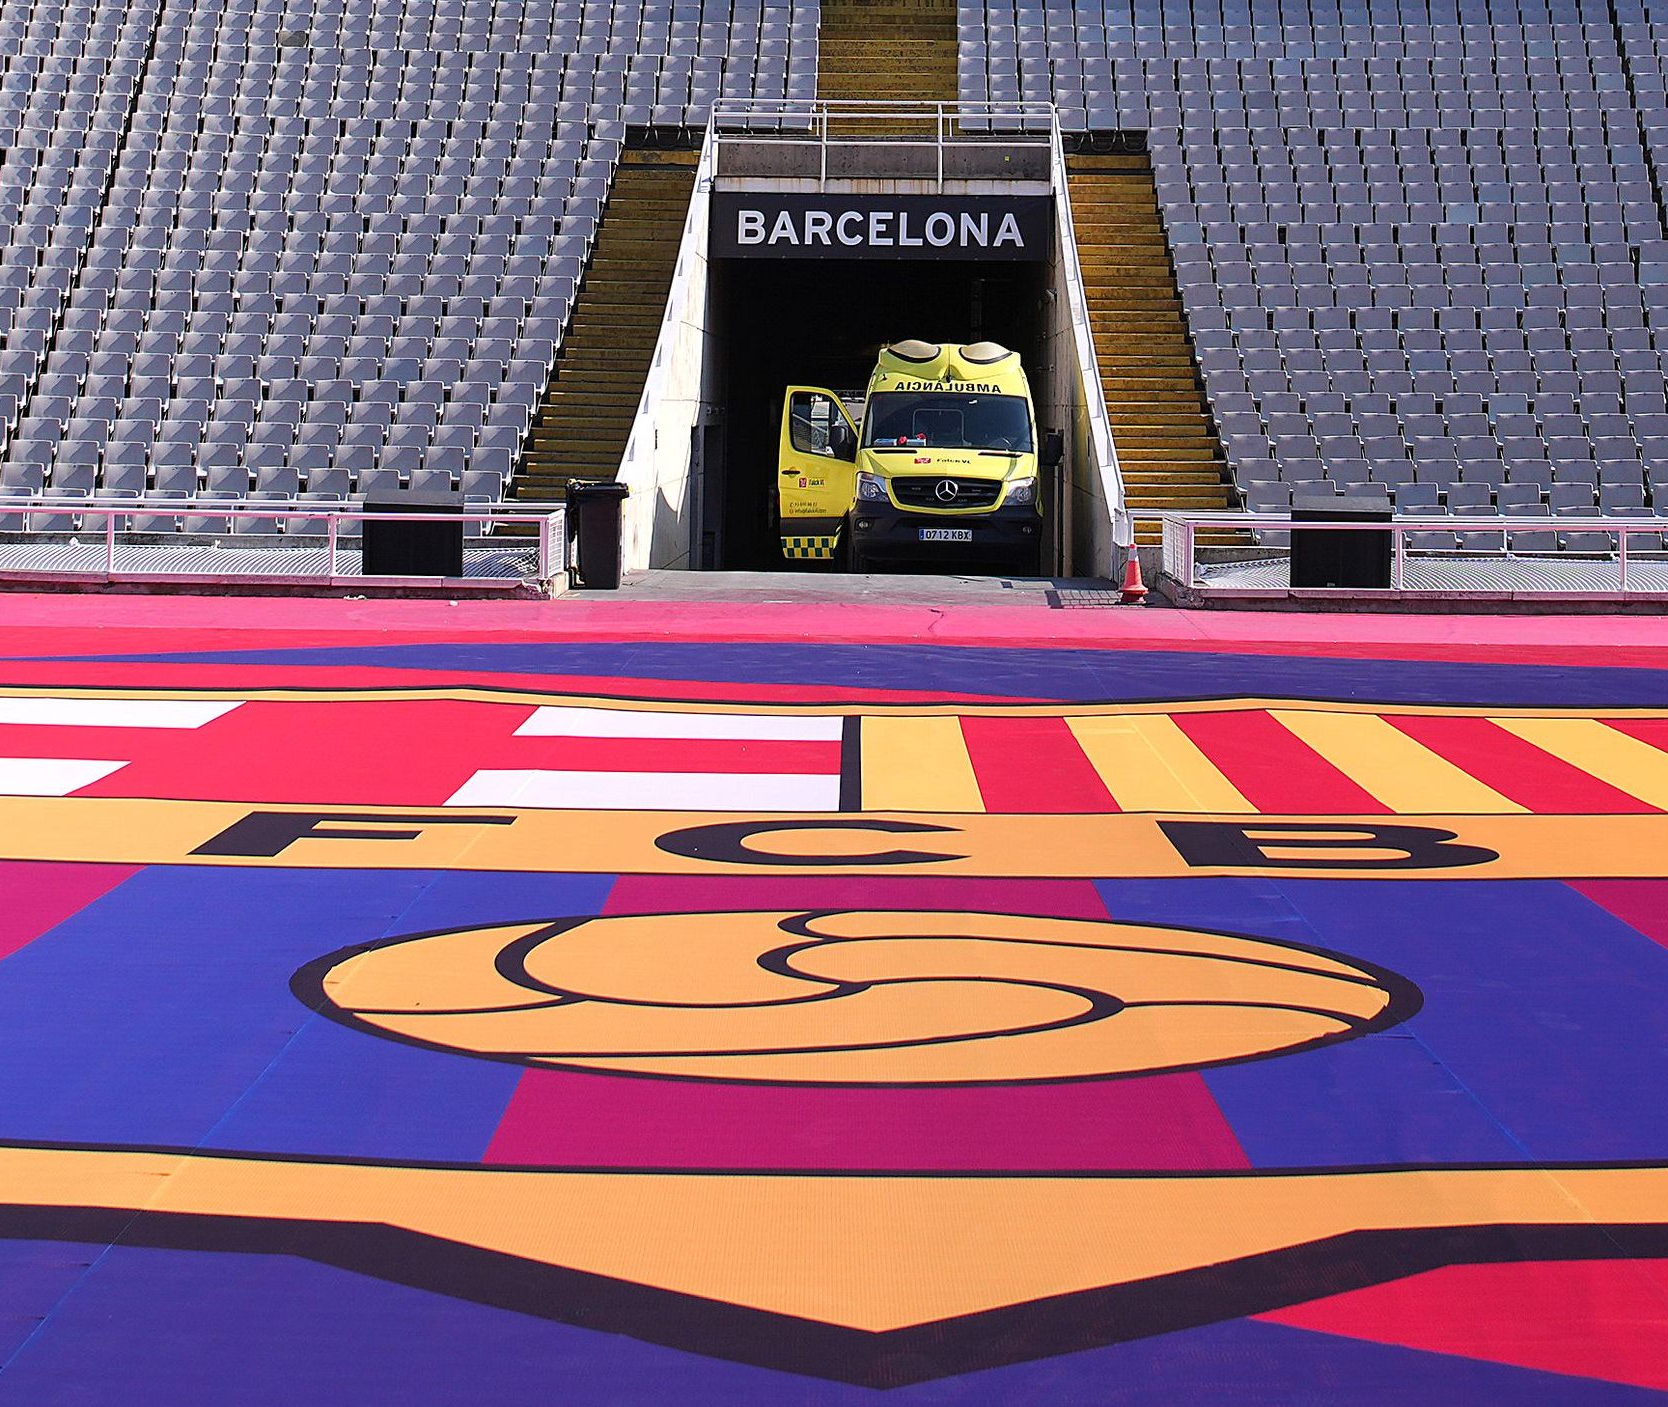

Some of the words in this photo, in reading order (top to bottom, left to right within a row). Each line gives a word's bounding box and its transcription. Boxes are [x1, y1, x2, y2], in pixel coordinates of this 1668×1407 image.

[737, 210, 1025, 247] BARCELONA
[925, 530, 949, 540] 0712
[951, 530, 969, 540] KBX
